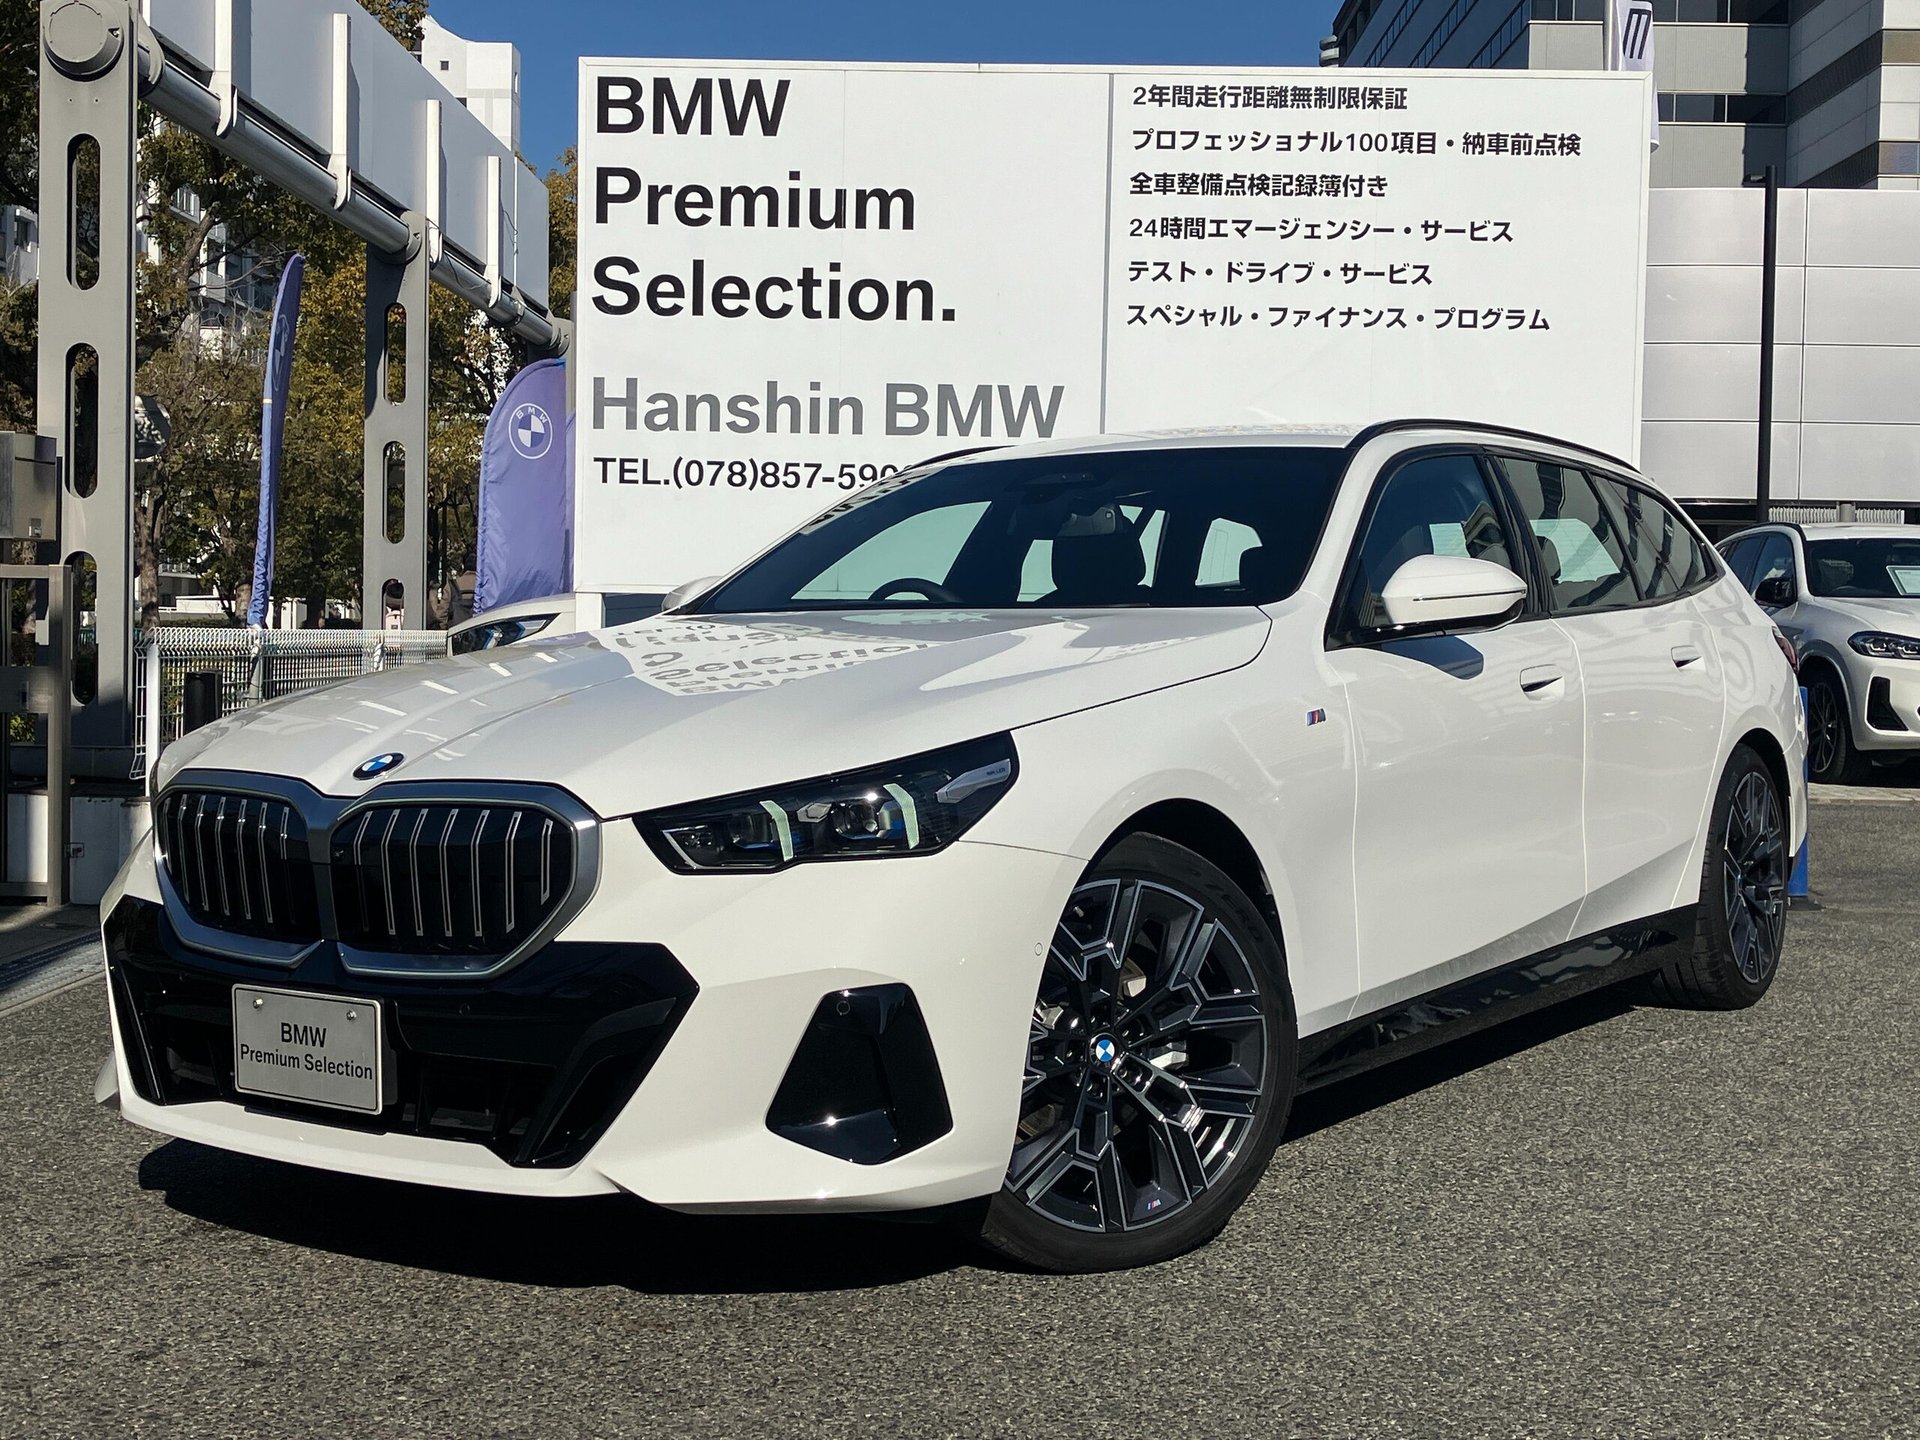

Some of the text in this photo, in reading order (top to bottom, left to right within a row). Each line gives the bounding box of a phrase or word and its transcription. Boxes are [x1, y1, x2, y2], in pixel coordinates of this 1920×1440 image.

[597, 76, 791, 136] BMW
[1133, 84, 1407, 110] 2年間走行距離無制限保証
[1133, 127, 1582, 157] プロフェッショナル100項目・納車前点検
[596, 167, 914, 230] Premium
[1130, 171, 1388, 198] 全車整備点検記録簿付き
[1129, 216, 1514, 243] 24時間エマージェンシー・サービス
[1128, 260, 1433, 286] テスト・ドライブ・サービス
[592, 256, 956, 321] Selection.
[1126, 304, 1550, 331] スペシャル・ファイナンス・プログラム
[593, 376, 1065, 438] Hanshin BMW
[281, 1022, 327, 1048] BMW
[240, 1044, 373, 1080] Premium Selection
